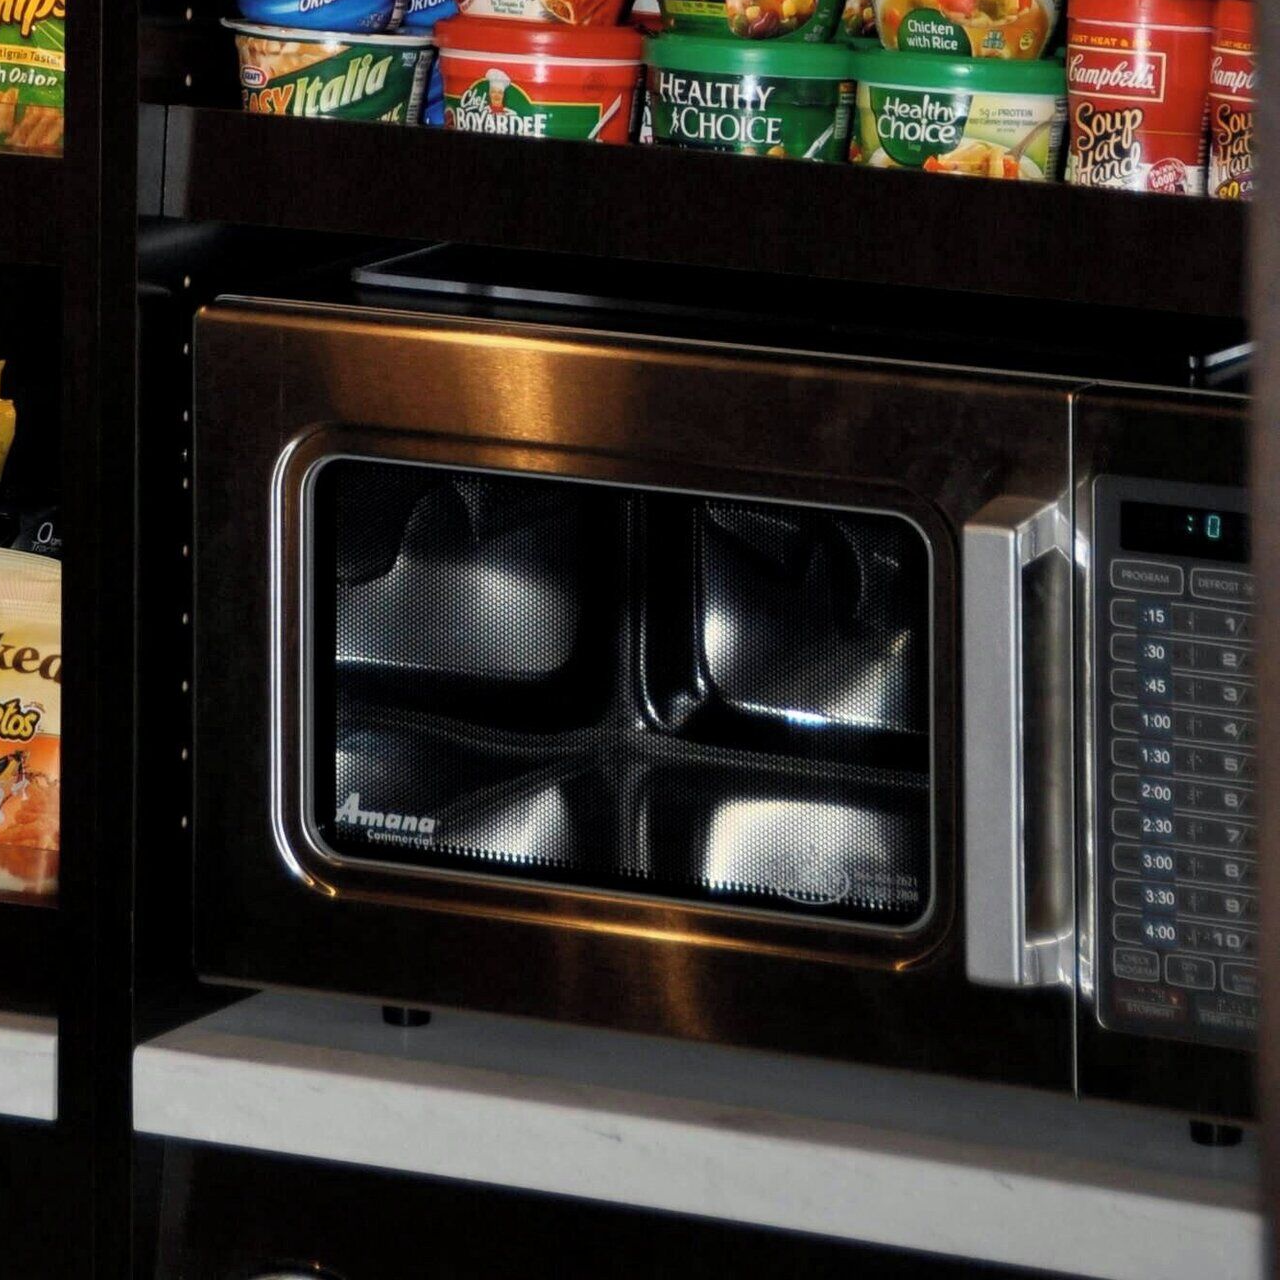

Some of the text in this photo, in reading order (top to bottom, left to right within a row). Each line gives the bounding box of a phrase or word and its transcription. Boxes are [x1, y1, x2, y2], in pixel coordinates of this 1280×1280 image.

[907, 19, 954, 35] Chicken
[906, 35, 958, 51] with Rice
[1090, 35, 1117, 46] HEAT
[9, 68, 58, 87] Onion
[1069, 53, 1155, 90] Campbell's
[292, 53, 393, 118] Italia
[659, 72, 775, 112] HEALTHY
[461, 89, 487, 114] Chef
[884, 94, 960, 126] Healthy
[997, 108, 1033, 118] PROTEIN
[456, 111, 547, 137] BOYARDEE
[680, 106, 783, 144] CHOICE
[877, 115, 957, 144] Choice
[1075, 101, 1143, 151] Soup
[1094, 133, 1123, 161] at
[1078, 141, 1142, 185] Hand
[1122, 569, 1240, 592] PROGRAM DEFROST
[1142, 714, 1171, 730] 1:00
[1142, 749, 1170, 764] 1:30
[1142, 784, 1171, 801] 2:00
[335, 792, 437, 833] Amana
[1143, 819, 1172, 834] 2:30
[366, 829, 434, 847] Commercial
[1144, 855, 1173, 870] 3:00
[1145, 890, 1175, 906] 3:30
[1146, 925, 1175, 941] 4:00
